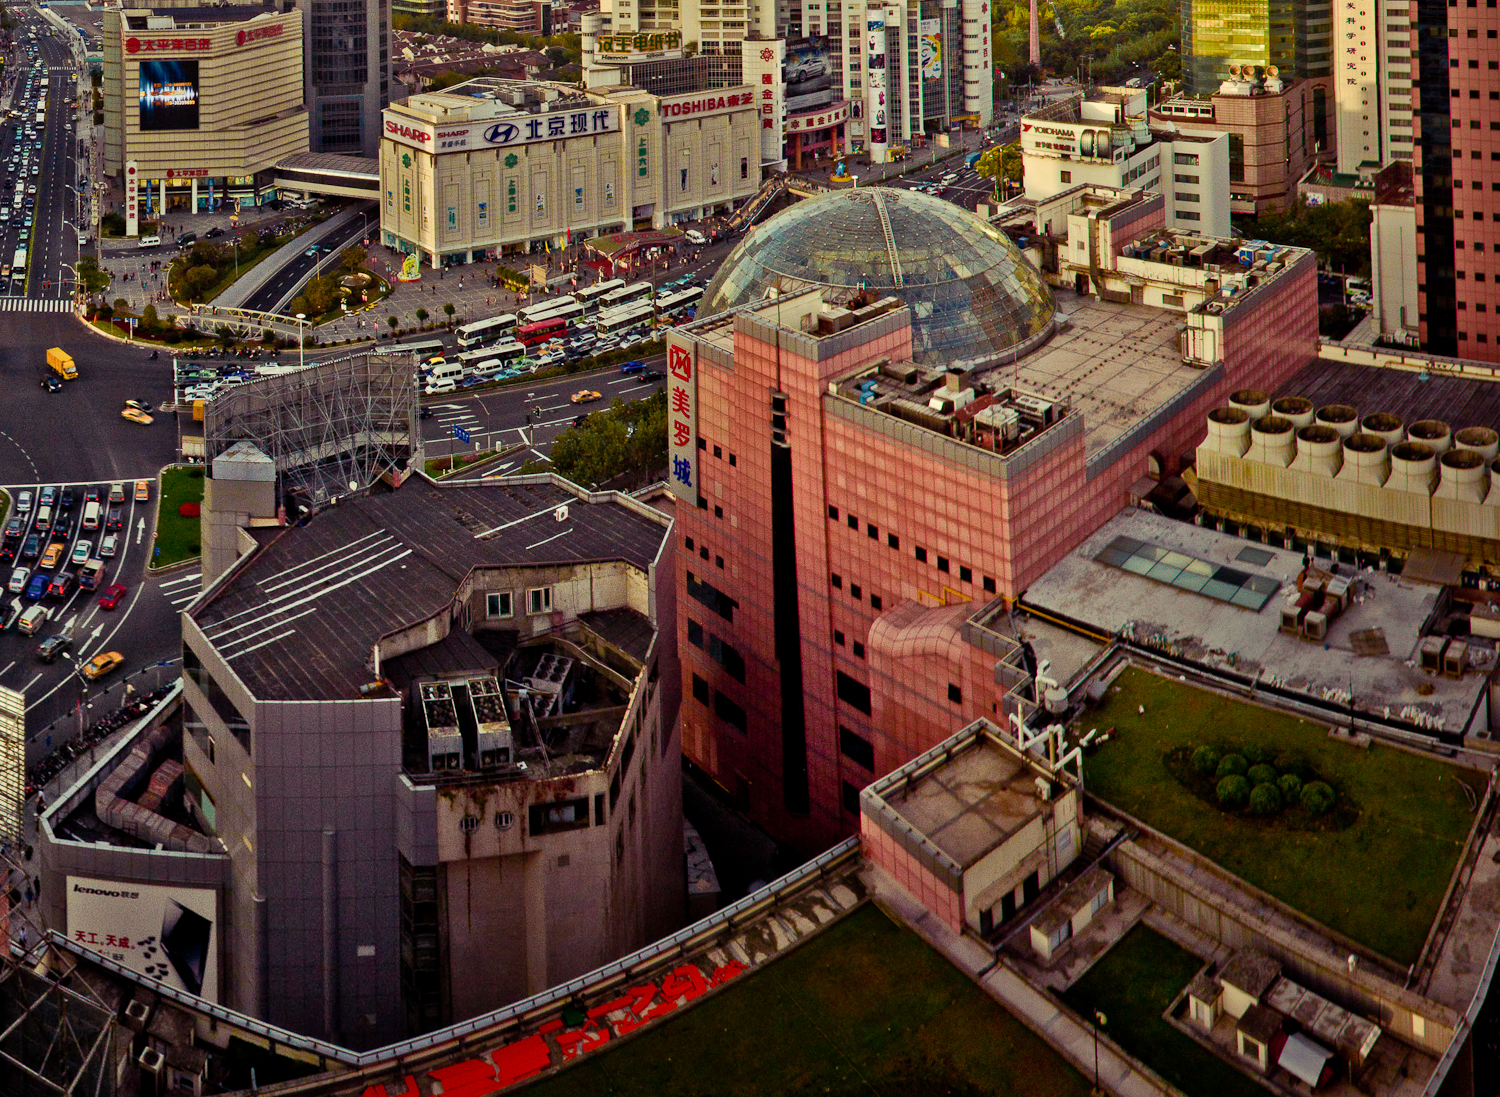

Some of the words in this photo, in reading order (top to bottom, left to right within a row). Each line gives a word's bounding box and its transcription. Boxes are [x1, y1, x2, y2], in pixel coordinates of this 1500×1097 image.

[598, 32, 679, 53] 汉王电纸书
[662, 96, 726, 117] TOSHIBA
[385, 120, 431, 144] SHARP
[437, 129, 469, 139] SHARP
[525, 110, 610, 141] 北京现代
[1033, 126, 1076, 138] YOKOHAMA
[672, 386, 692, 488] 美罗城
[73, 884, 120, 898] lenovo
